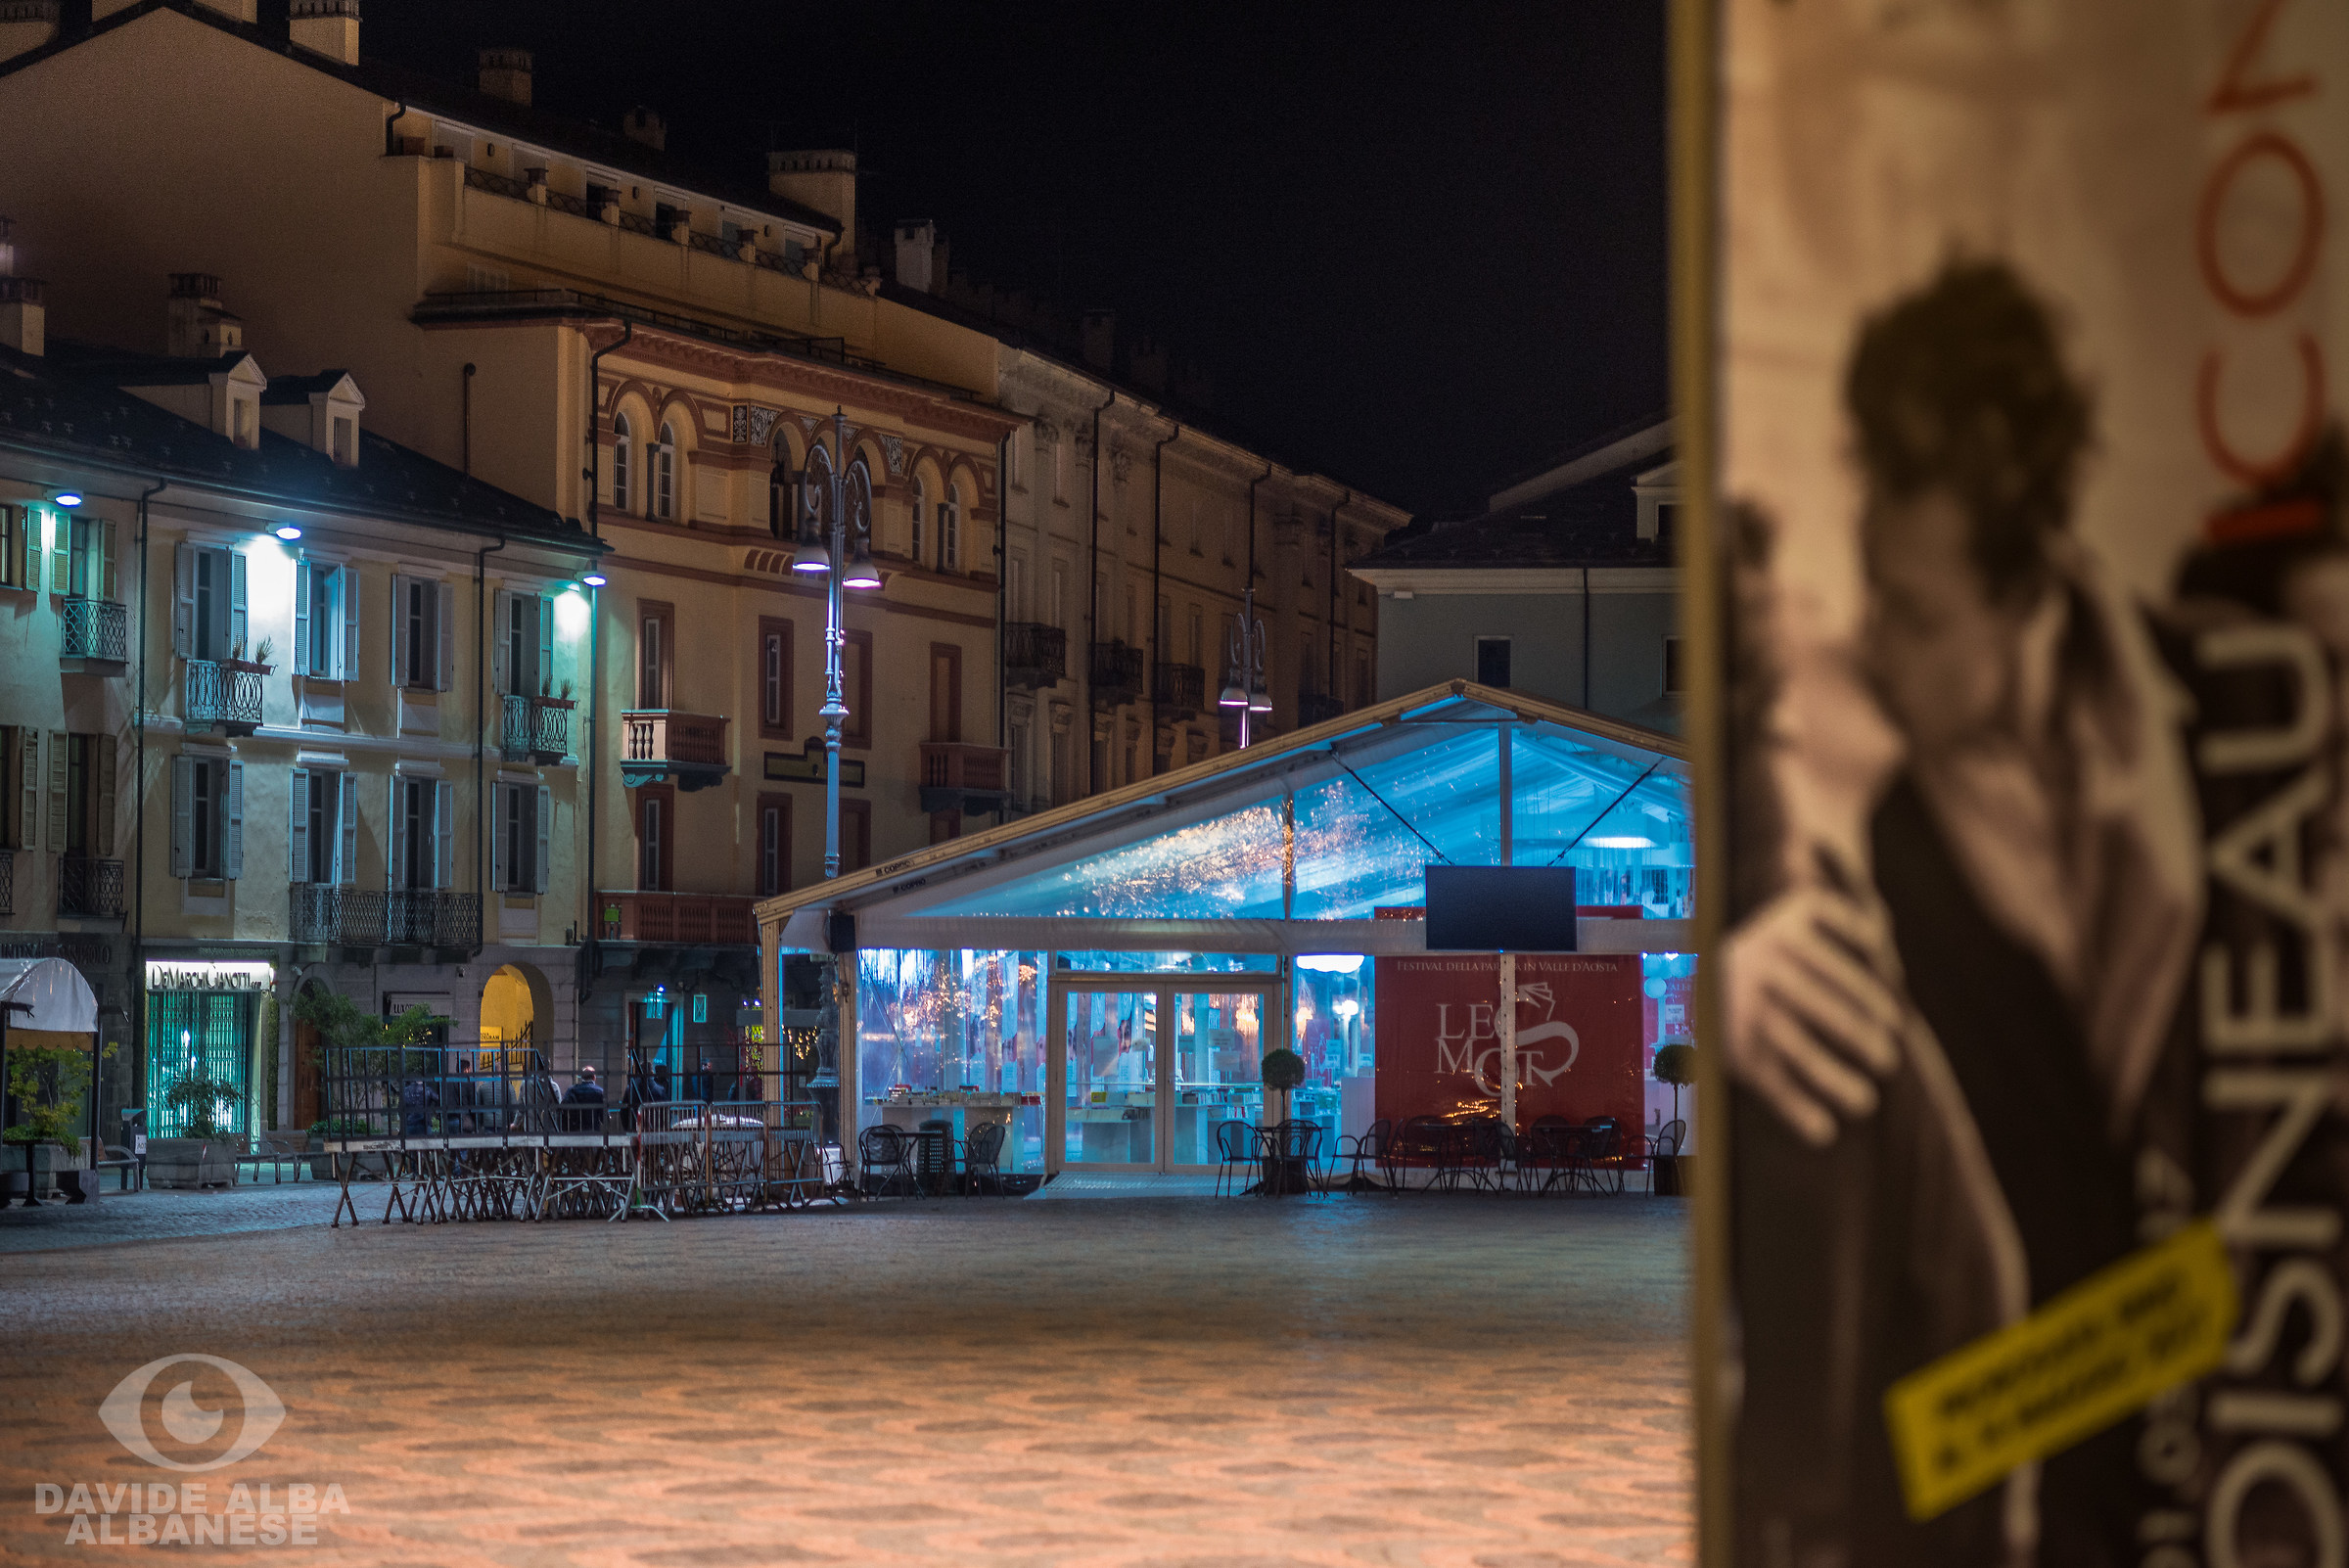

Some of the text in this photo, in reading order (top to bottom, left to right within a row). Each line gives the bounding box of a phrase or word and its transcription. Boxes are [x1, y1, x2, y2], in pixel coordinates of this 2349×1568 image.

[1447, 961, 1479, 971] DELLA
[1524, 961, 1537, 971] IN
[1538, 961, 1570, 972] VALLE
